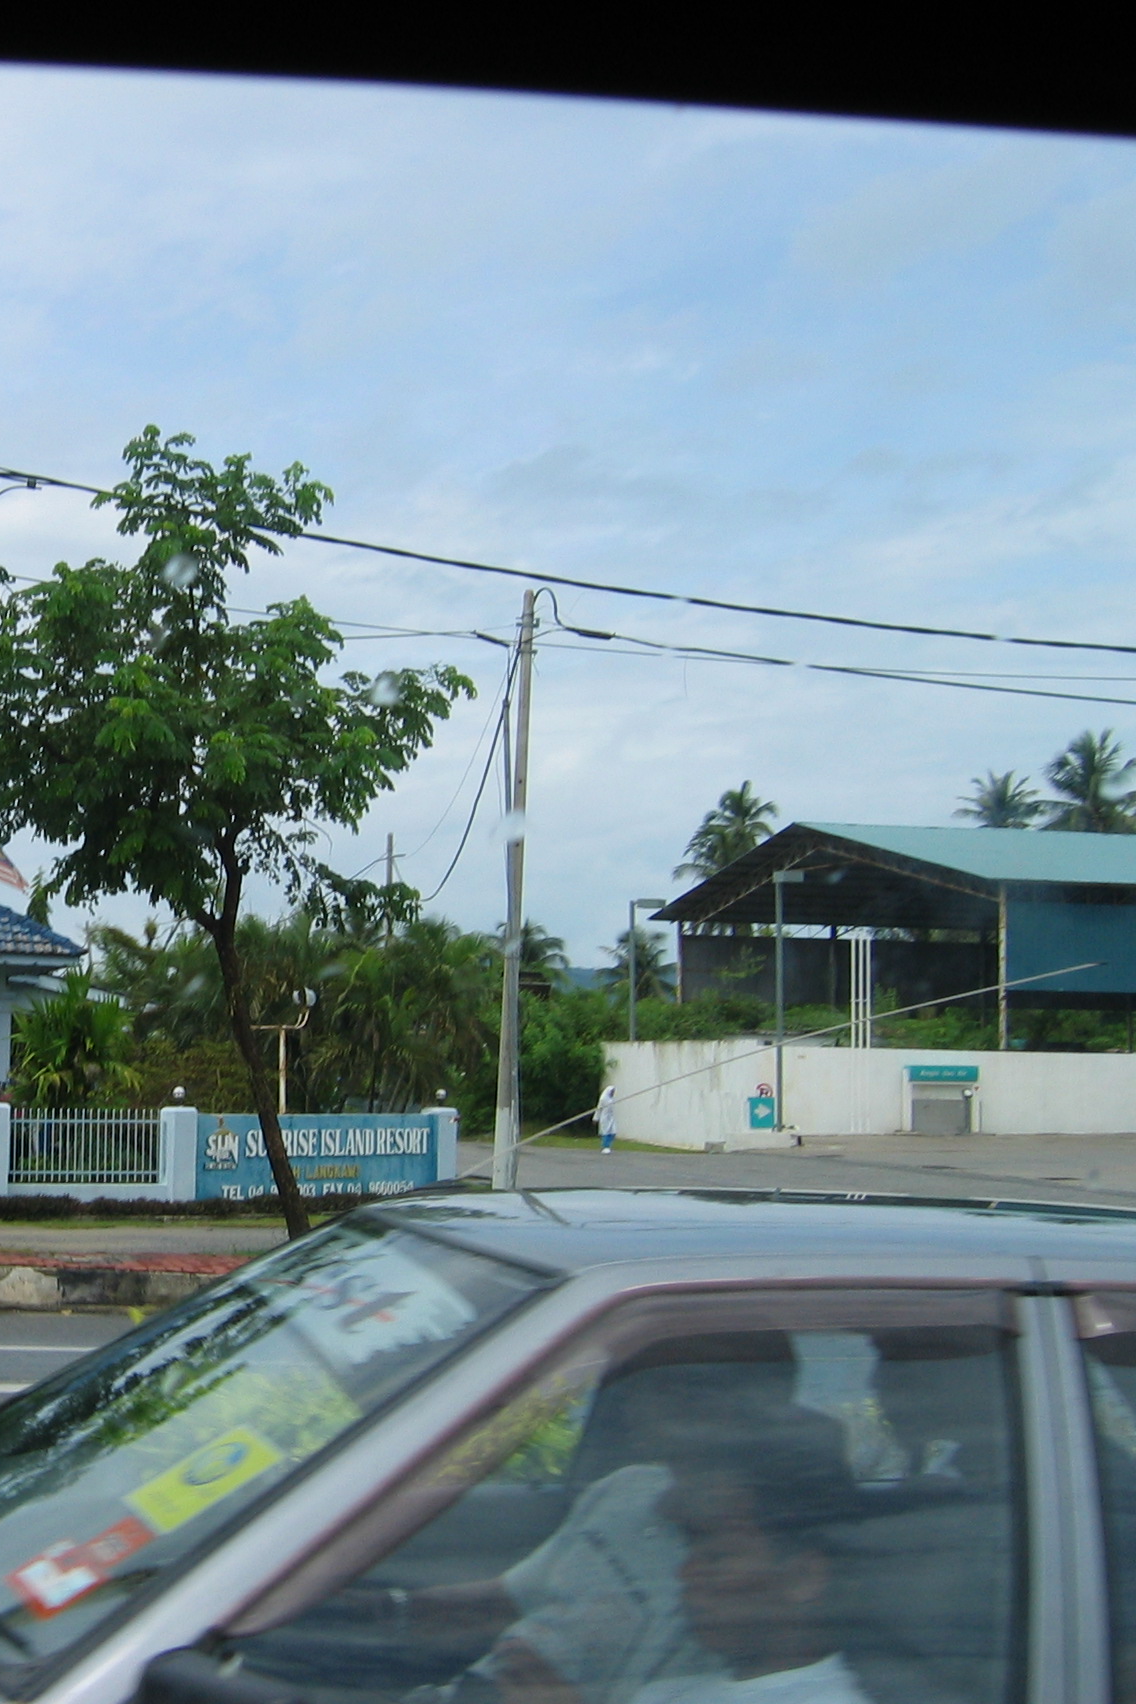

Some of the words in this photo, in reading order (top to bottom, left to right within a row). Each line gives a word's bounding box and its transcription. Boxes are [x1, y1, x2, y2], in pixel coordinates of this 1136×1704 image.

[246, 1128, 318, 1158] SURISE
[320, 1127, 375, 1157] ISLAND
[376, 1127, 430, 1154] RESORT
[306, 1165, 358, 1179] LANGKAWI
[222, 1184, 245, 1201] TEL
[248, 1184, 265, 1199] 04
[321, 1182, 344, 1196] FAX
